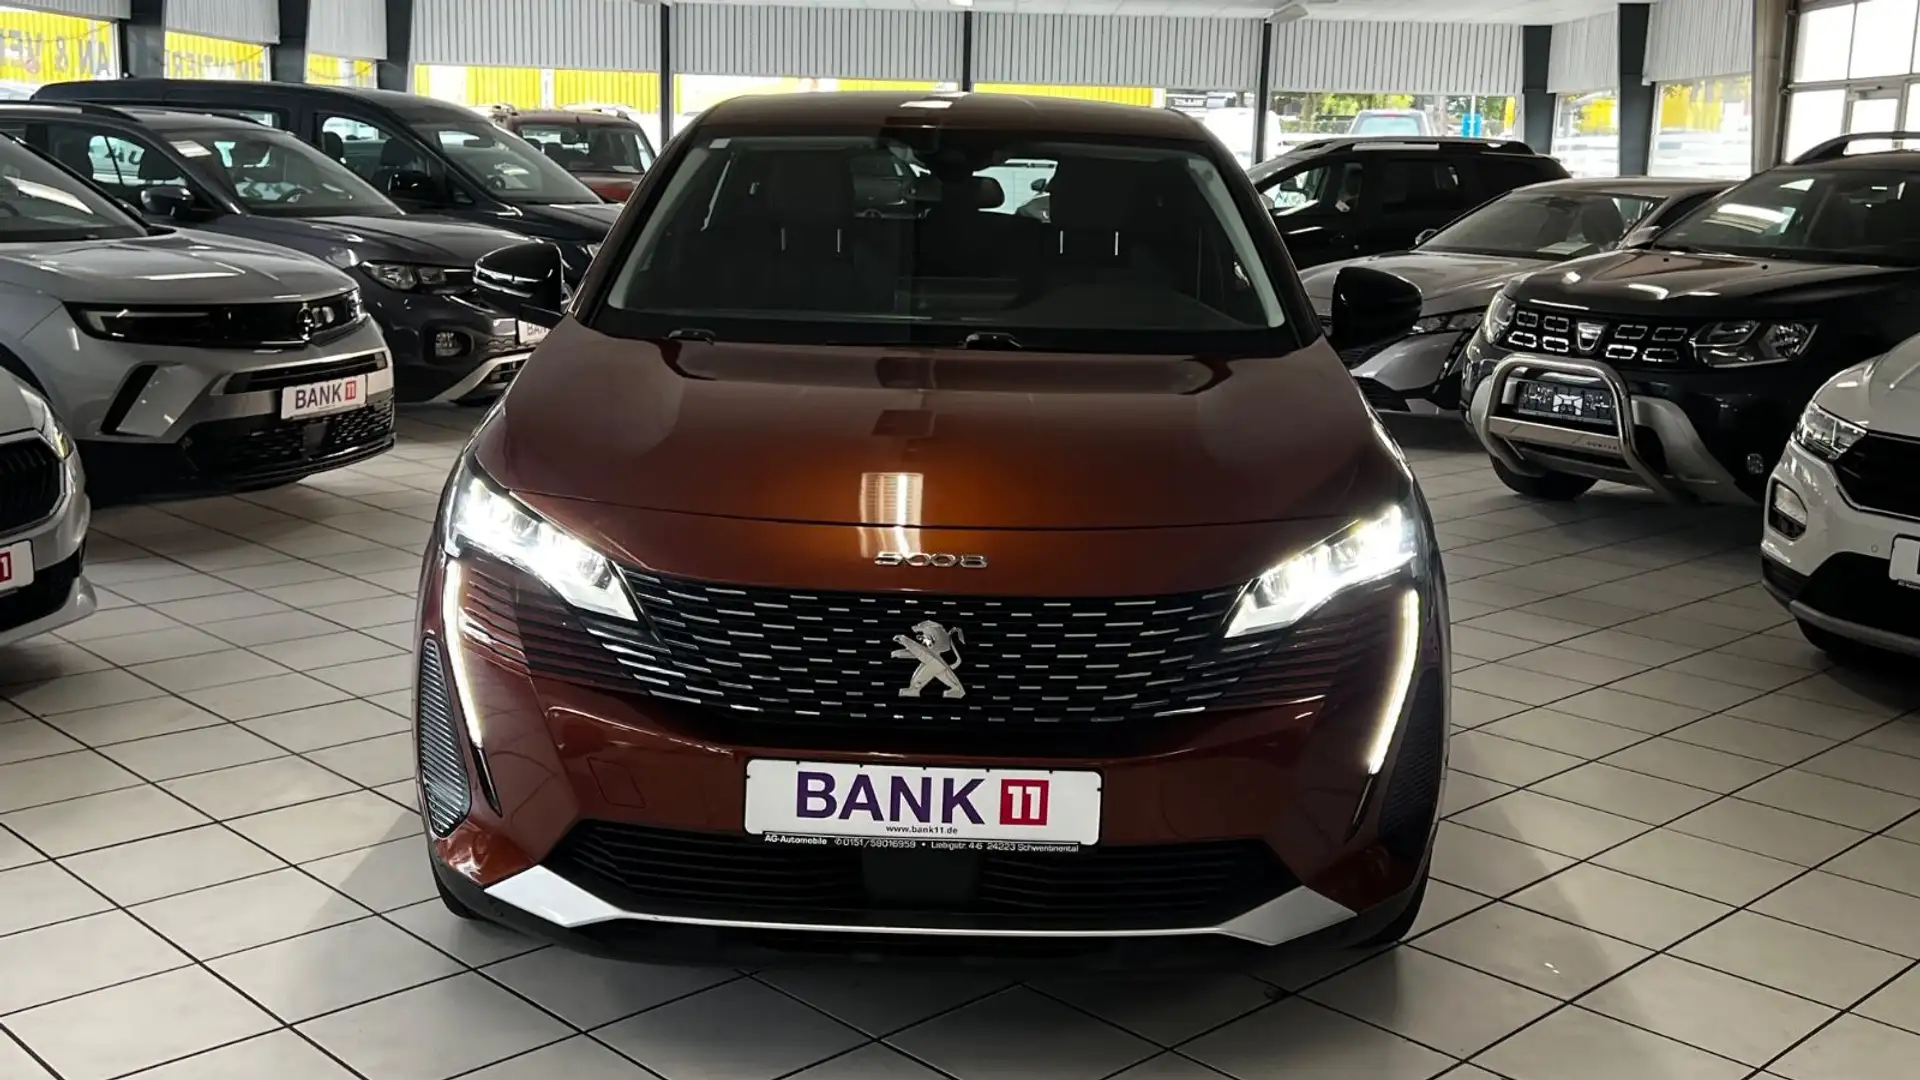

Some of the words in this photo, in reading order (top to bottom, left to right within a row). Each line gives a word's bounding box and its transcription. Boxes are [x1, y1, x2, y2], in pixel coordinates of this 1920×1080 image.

[295, 382, 342, 409] BANK
[796, 771, 985, 825] BANK
[1005, 783, 1044, 822] 11
[885, 825, 958, 834] www.bank11.de
[764, 834, 827, 845] AG-Automobile
[986, 842, 1016, 851] 24223
